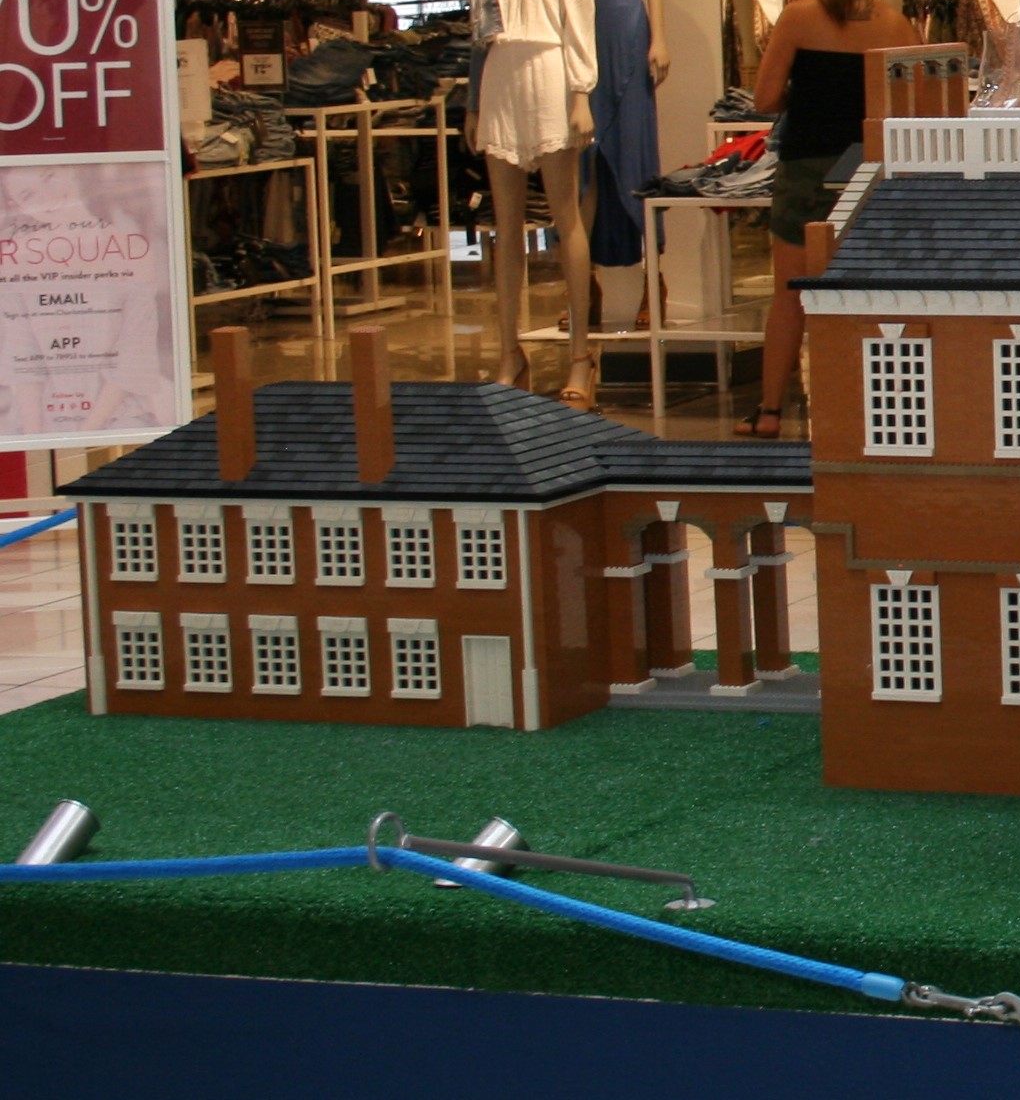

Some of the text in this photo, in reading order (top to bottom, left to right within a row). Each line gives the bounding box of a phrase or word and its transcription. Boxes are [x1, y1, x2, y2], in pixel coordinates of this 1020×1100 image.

[0, 61, 131, 131] OFF
[40, 271, 59, 280] VIP
[39, 292, 88, 306] EMAIL
[50, 337, 81, 349] APP
